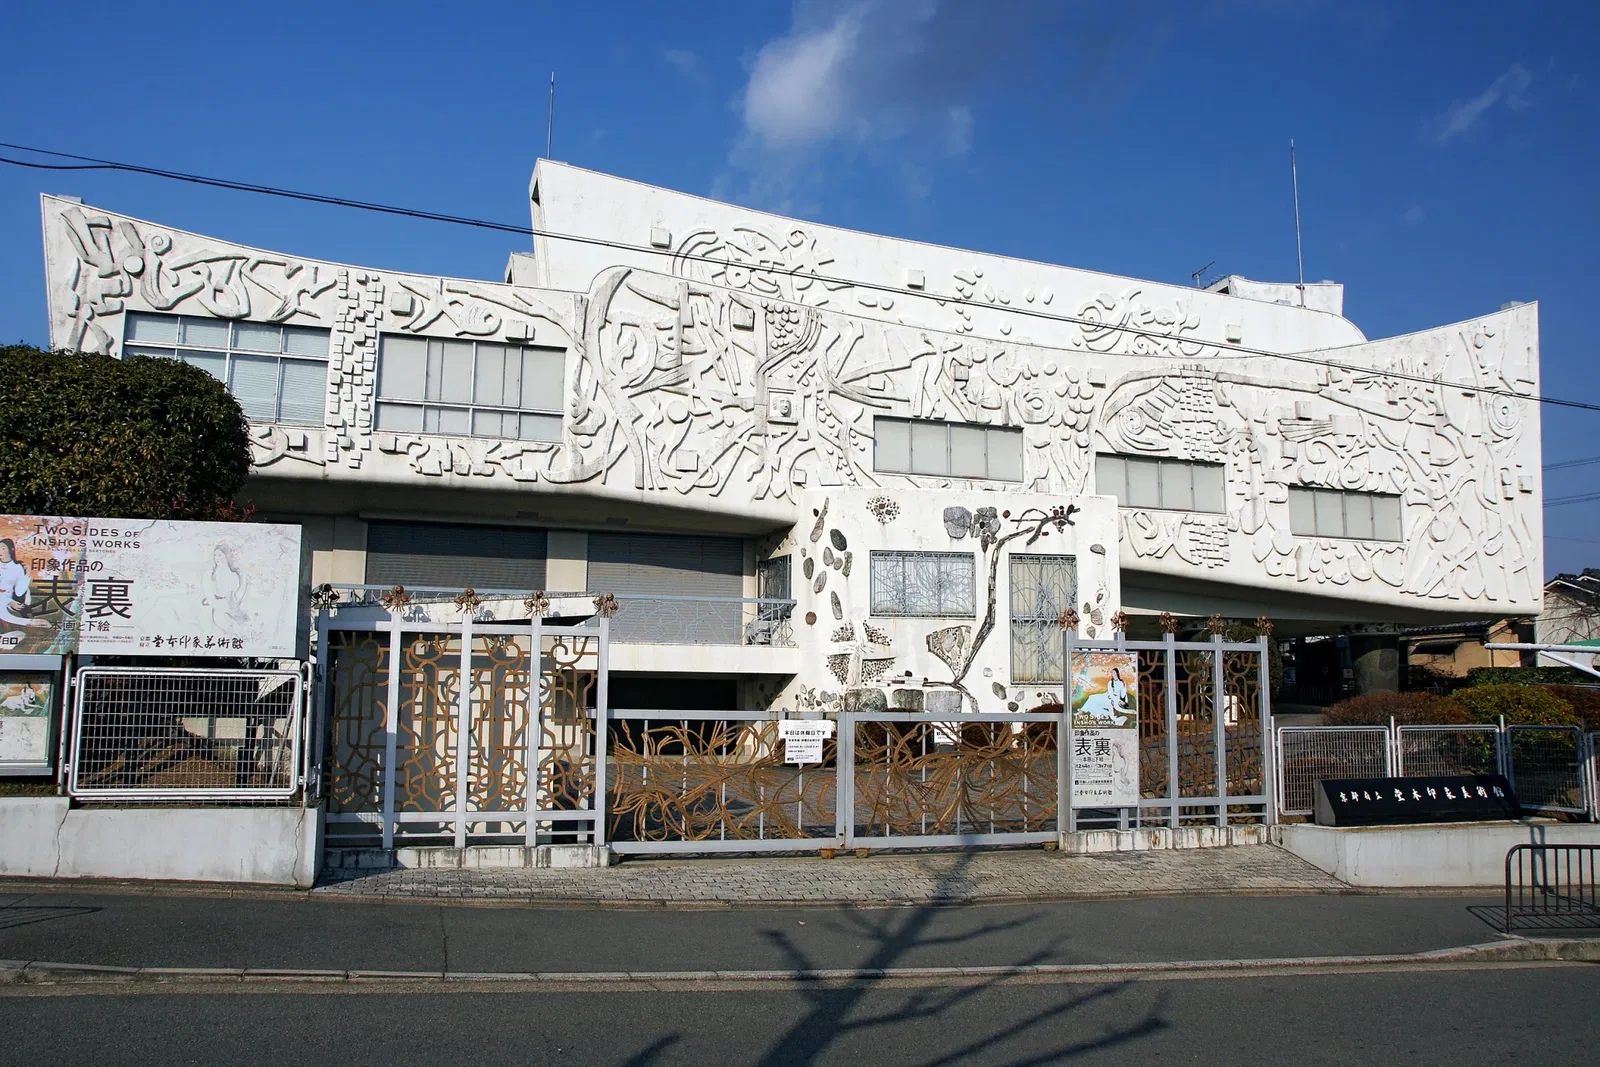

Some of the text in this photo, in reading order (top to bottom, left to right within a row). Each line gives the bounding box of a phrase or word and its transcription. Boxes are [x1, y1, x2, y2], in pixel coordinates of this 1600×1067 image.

[33, 524, 140, 538] TWO SIDES OF
[33, 536, 141, 549] INSHO'S WORKS
[30, 557, 104, 572] 印象作品の
[49, 620, 110, 632] 本画と下絵
[1074, 737, 1111, 756] 表裏
